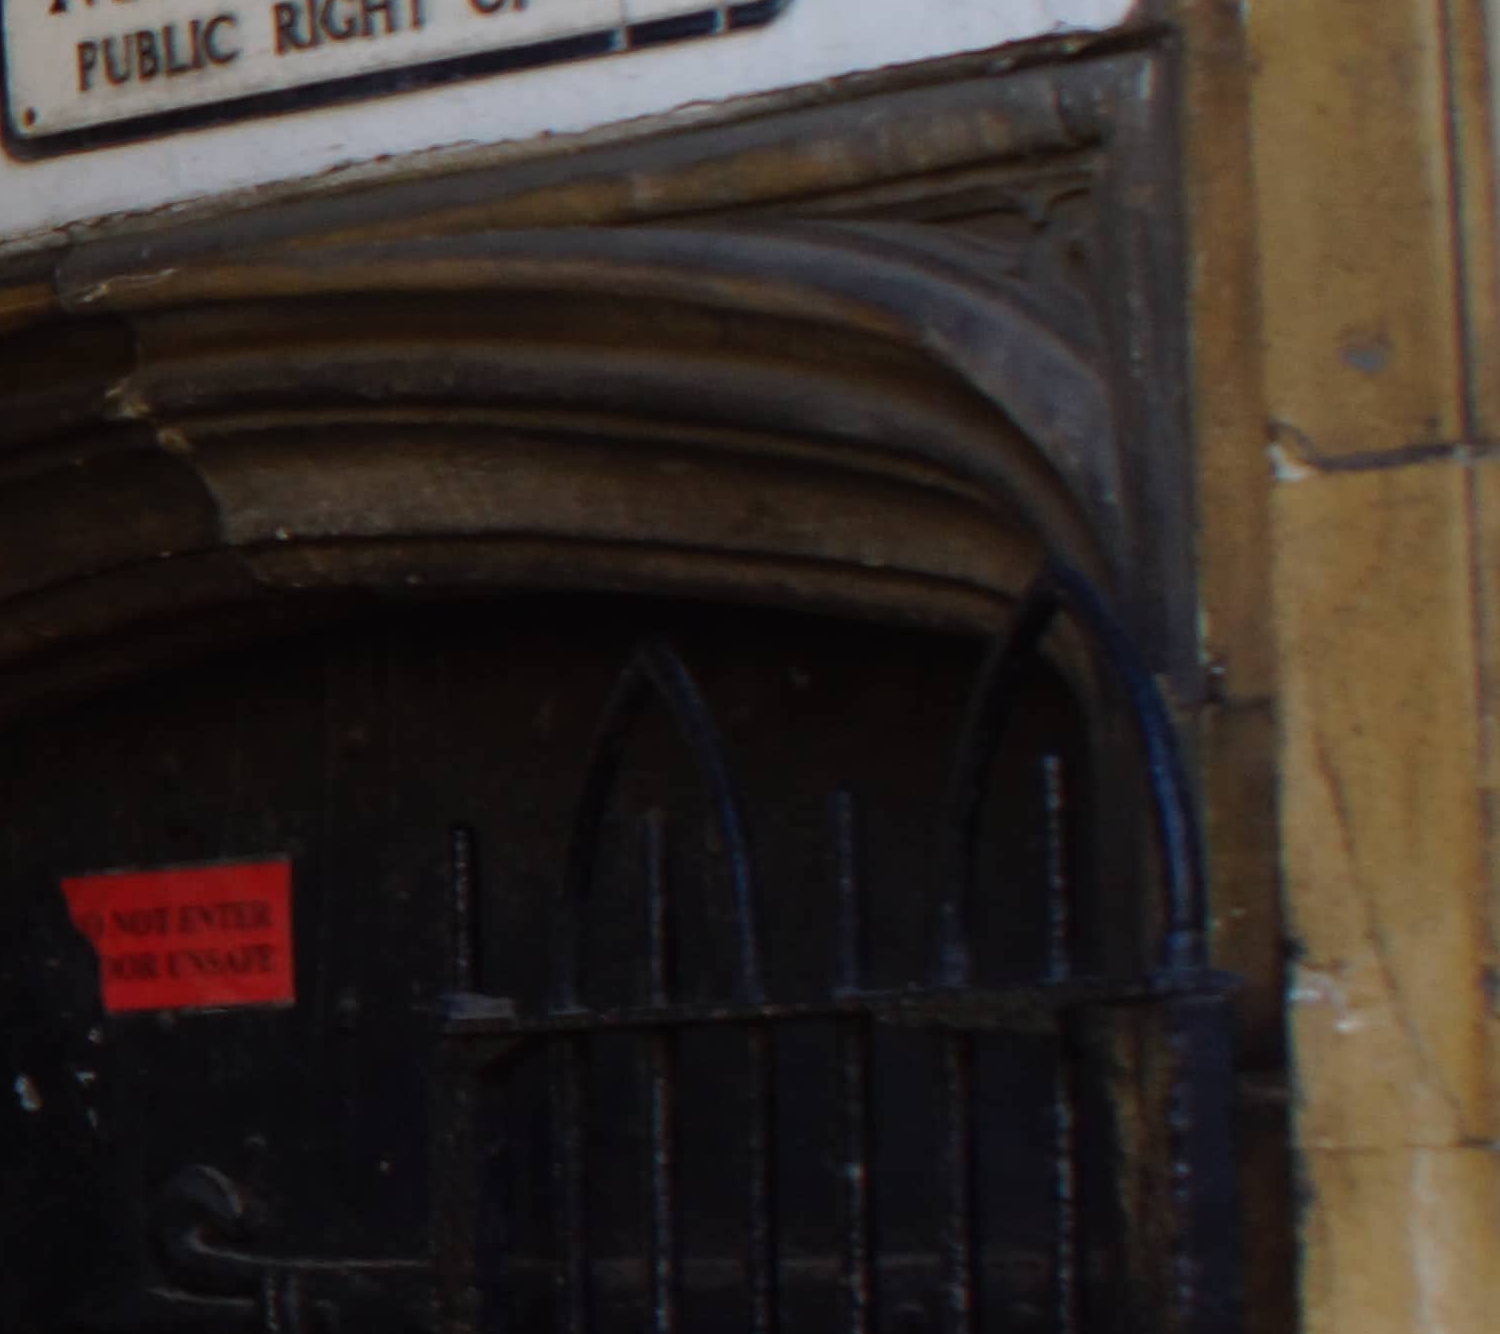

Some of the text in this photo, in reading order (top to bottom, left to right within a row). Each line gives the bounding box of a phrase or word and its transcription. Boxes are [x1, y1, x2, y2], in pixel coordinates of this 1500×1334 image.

[77, 16, 240, 93] PUBLIC
[111, 906, 168, 937] NOT
[178, 899, 272, 935] ENTER
